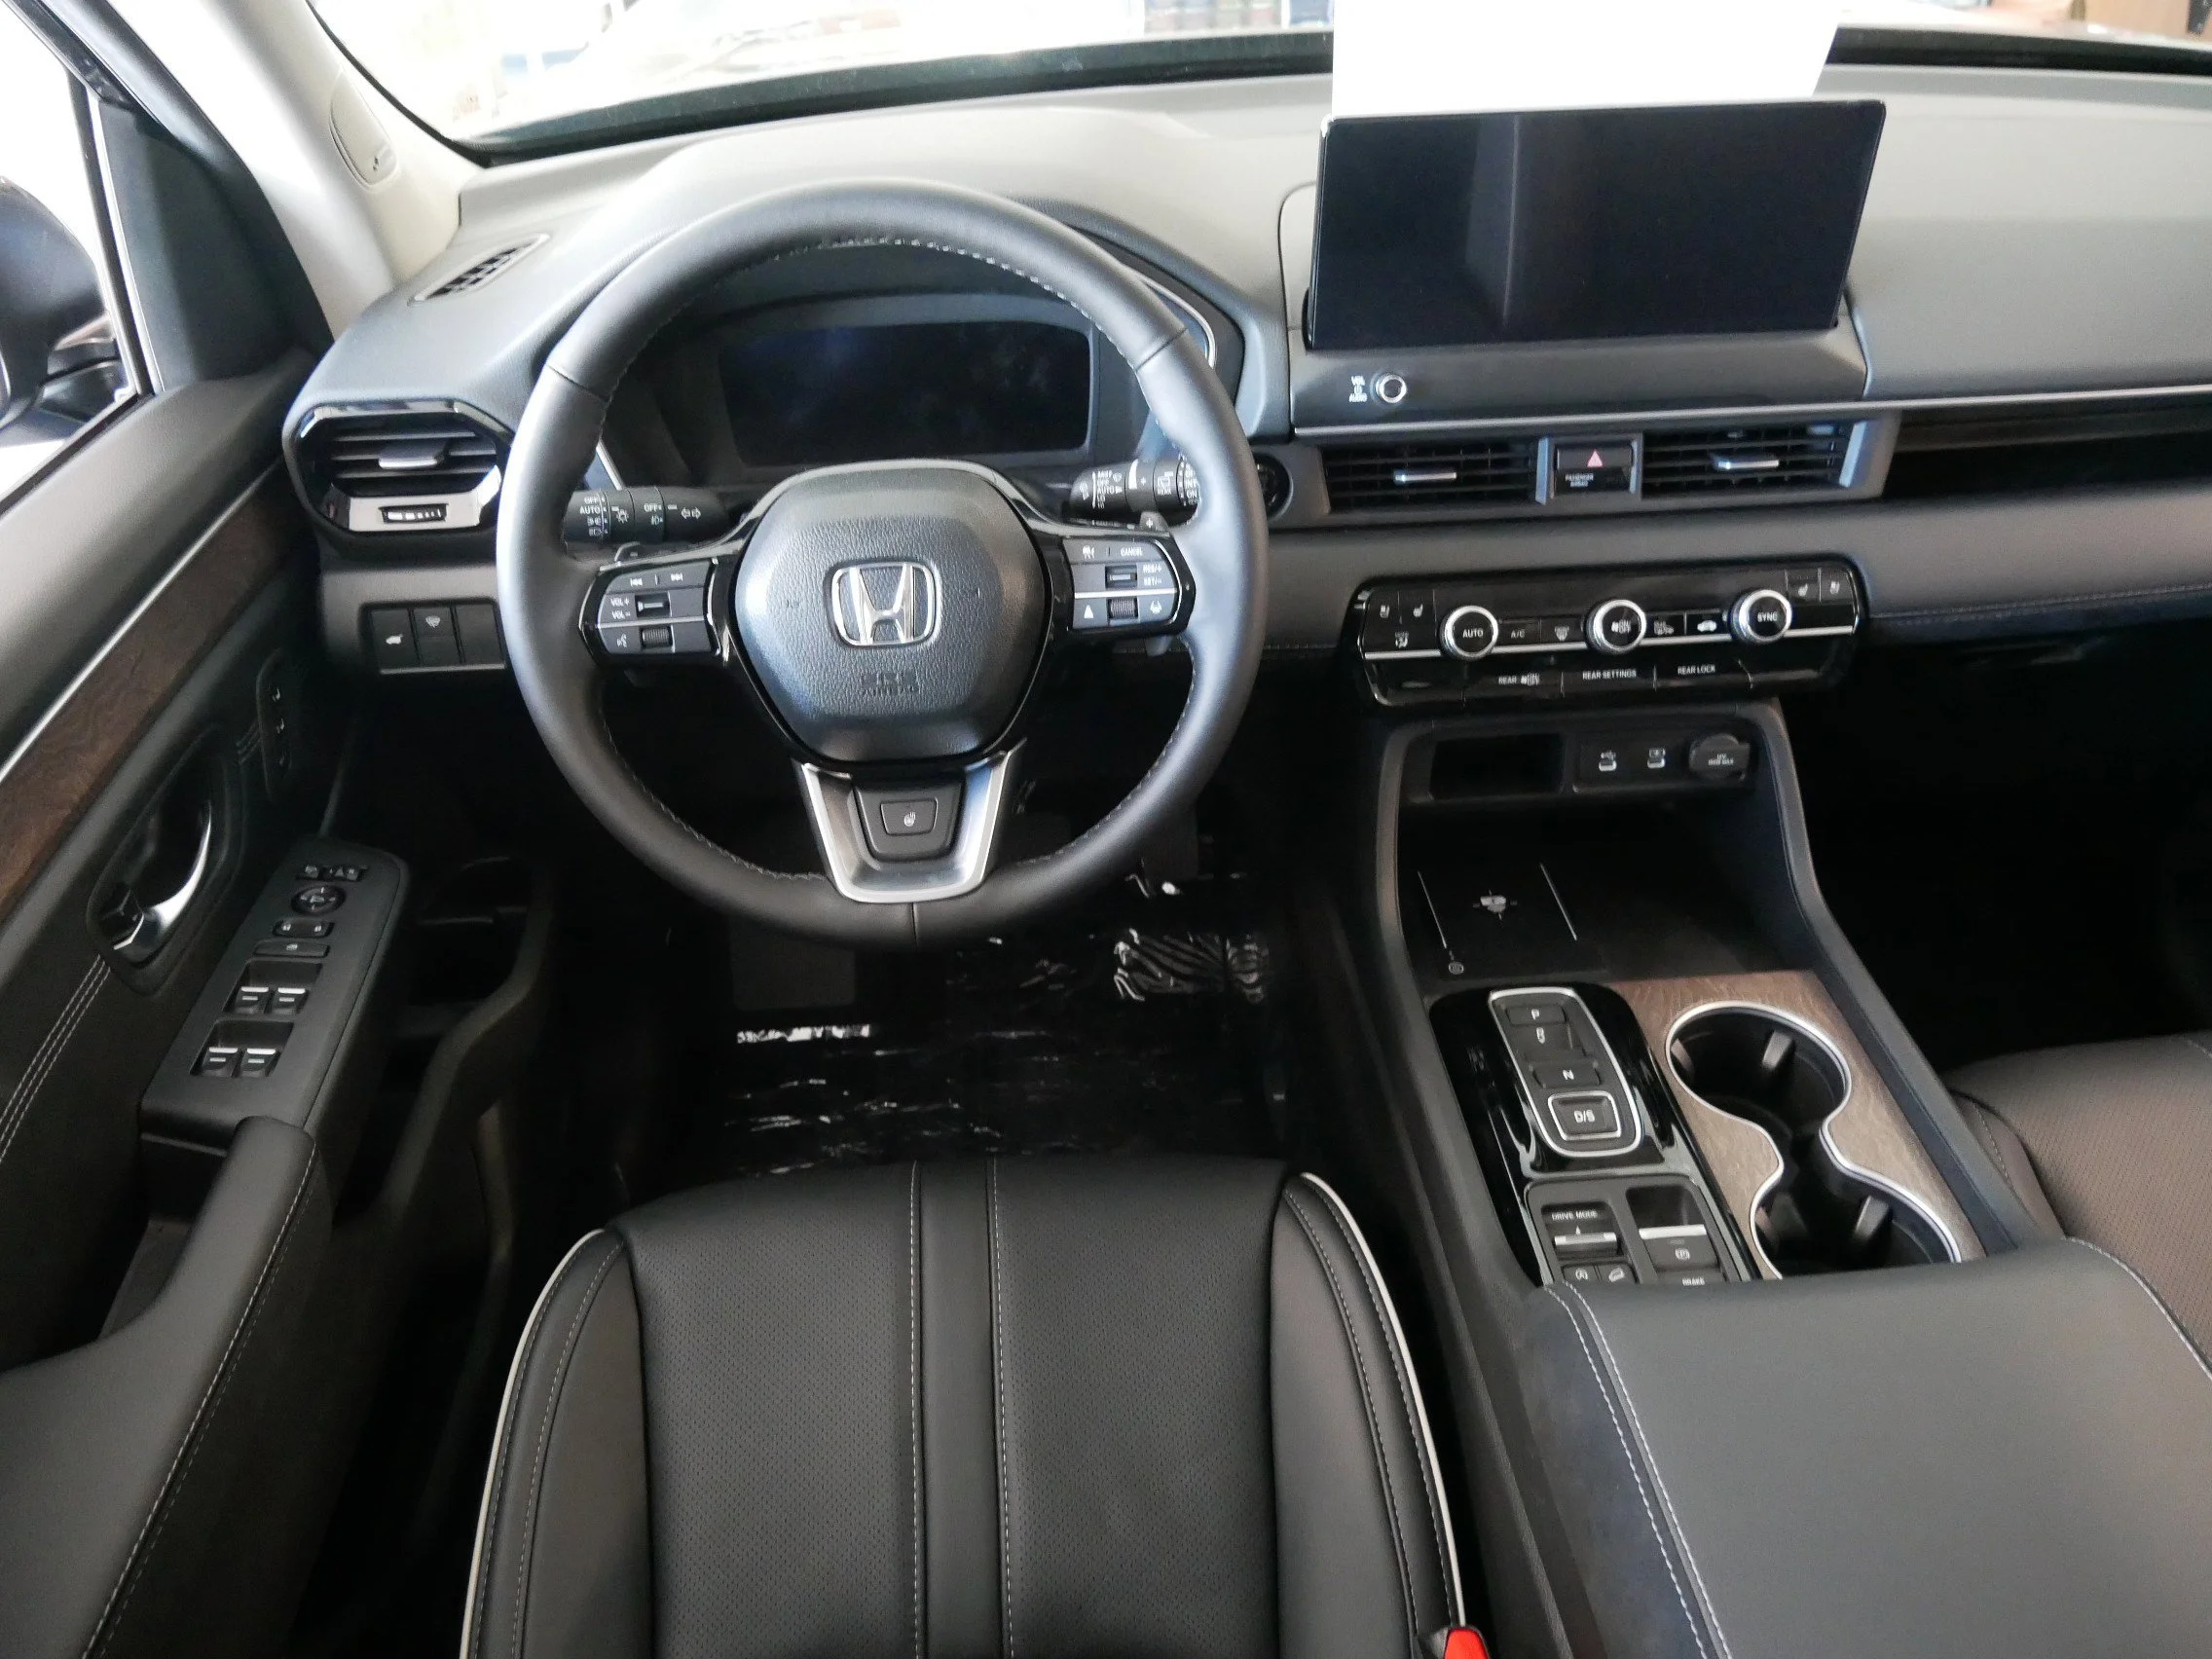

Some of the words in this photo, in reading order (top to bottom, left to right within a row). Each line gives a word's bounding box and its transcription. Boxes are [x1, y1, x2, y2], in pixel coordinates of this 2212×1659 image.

[580, 505, 601, 515] AUTO
[1757, 611, 1778, 622] SYNC
[1462, 629, 1484, 639] AUTO
[1511, 630, 1525, 639] A/C
[1582, 670, 1602, 680] REAR
[1602, 669, 1637, 679] SETTINGS
[1677, 666, 1696, 675] REAR
[1697, 665, 1715, 674] LOCK
[1530, 1009, 1540, 1020] P
[1563, 1069, 1574, 1081] N
[1573, 1110, 1596, 1123] D/S
[1552, 1211, 1574, 1221] DRIVE
[1575, 1209, 1598, 1220] MODE
